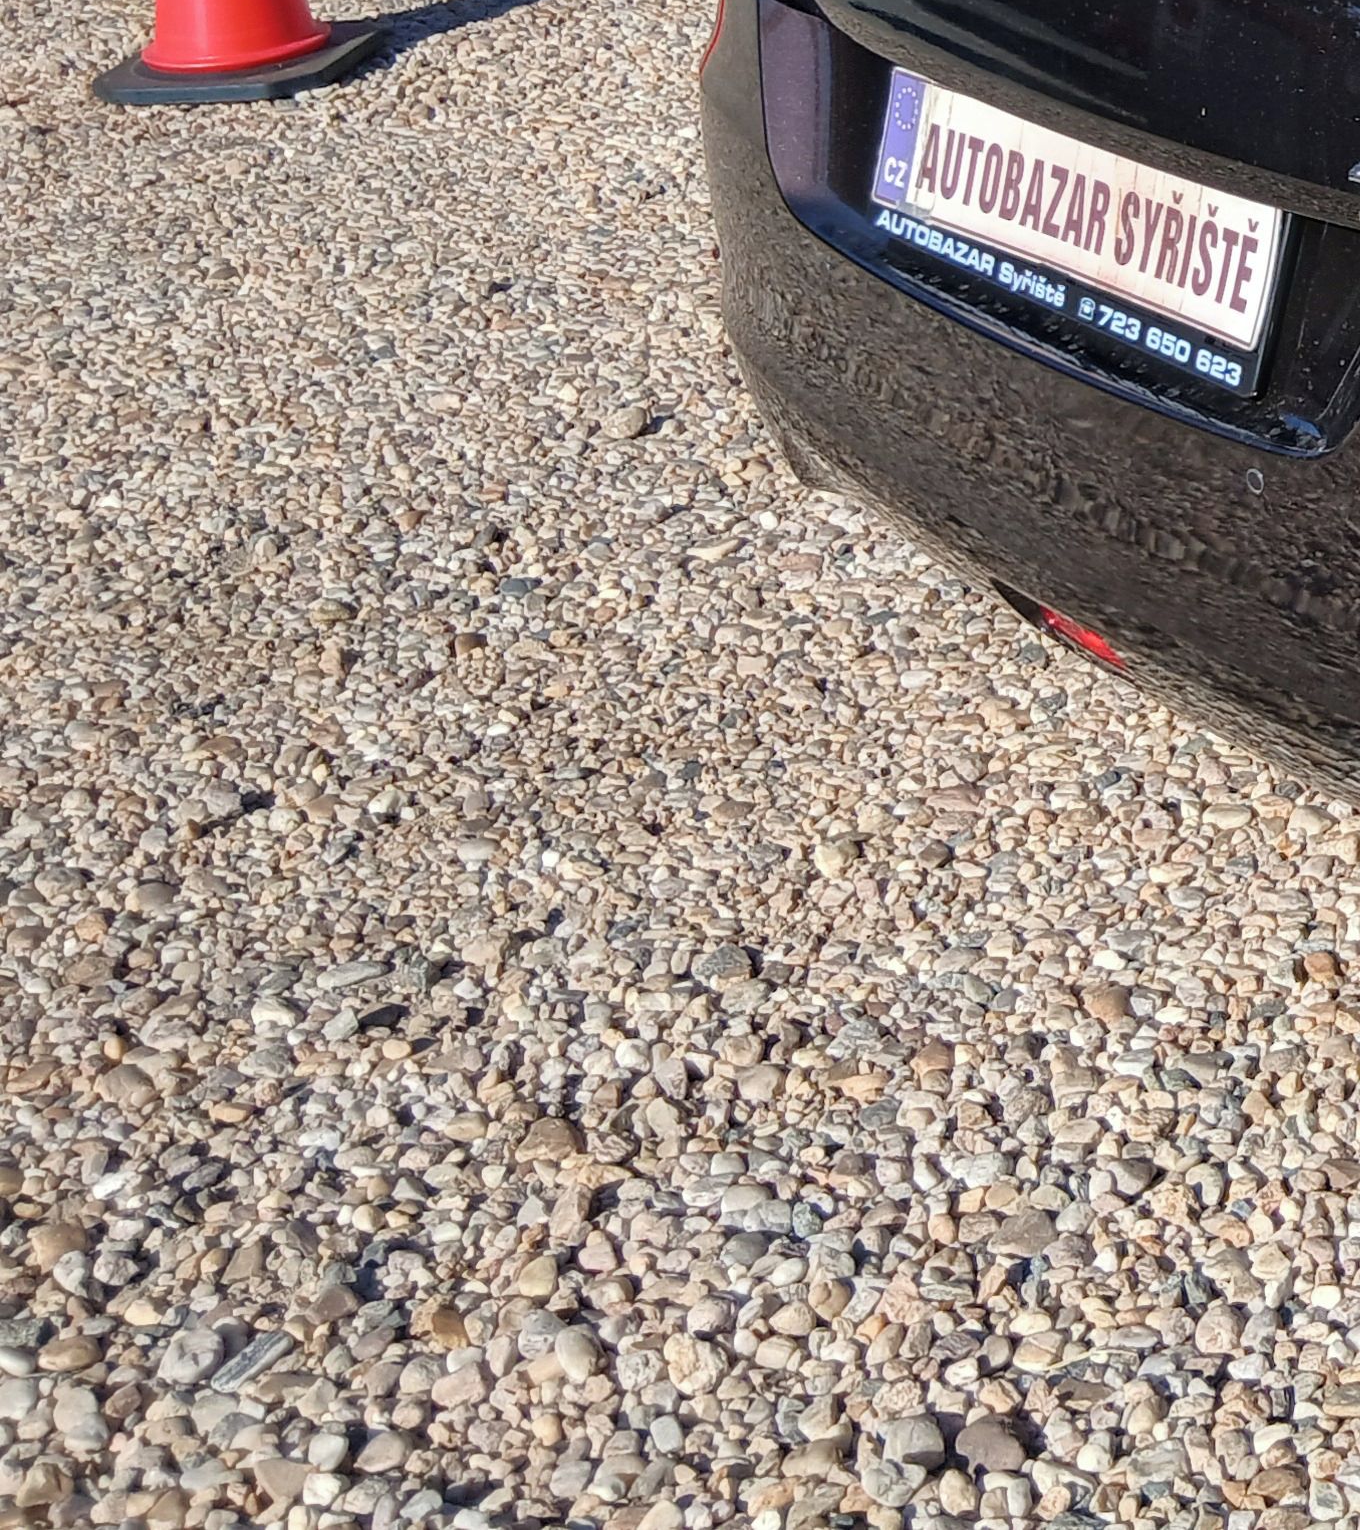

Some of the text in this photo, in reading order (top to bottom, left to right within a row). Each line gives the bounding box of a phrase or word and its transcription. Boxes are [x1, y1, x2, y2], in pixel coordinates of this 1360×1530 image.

[884, 156, 908, 189] CZ
[914, 123, 1260, 314] AUTOBAZAR SYŘIŠTĚ
[875, 209, 1242, 387] AUTOBAZAR Syřiště 723 650 623
